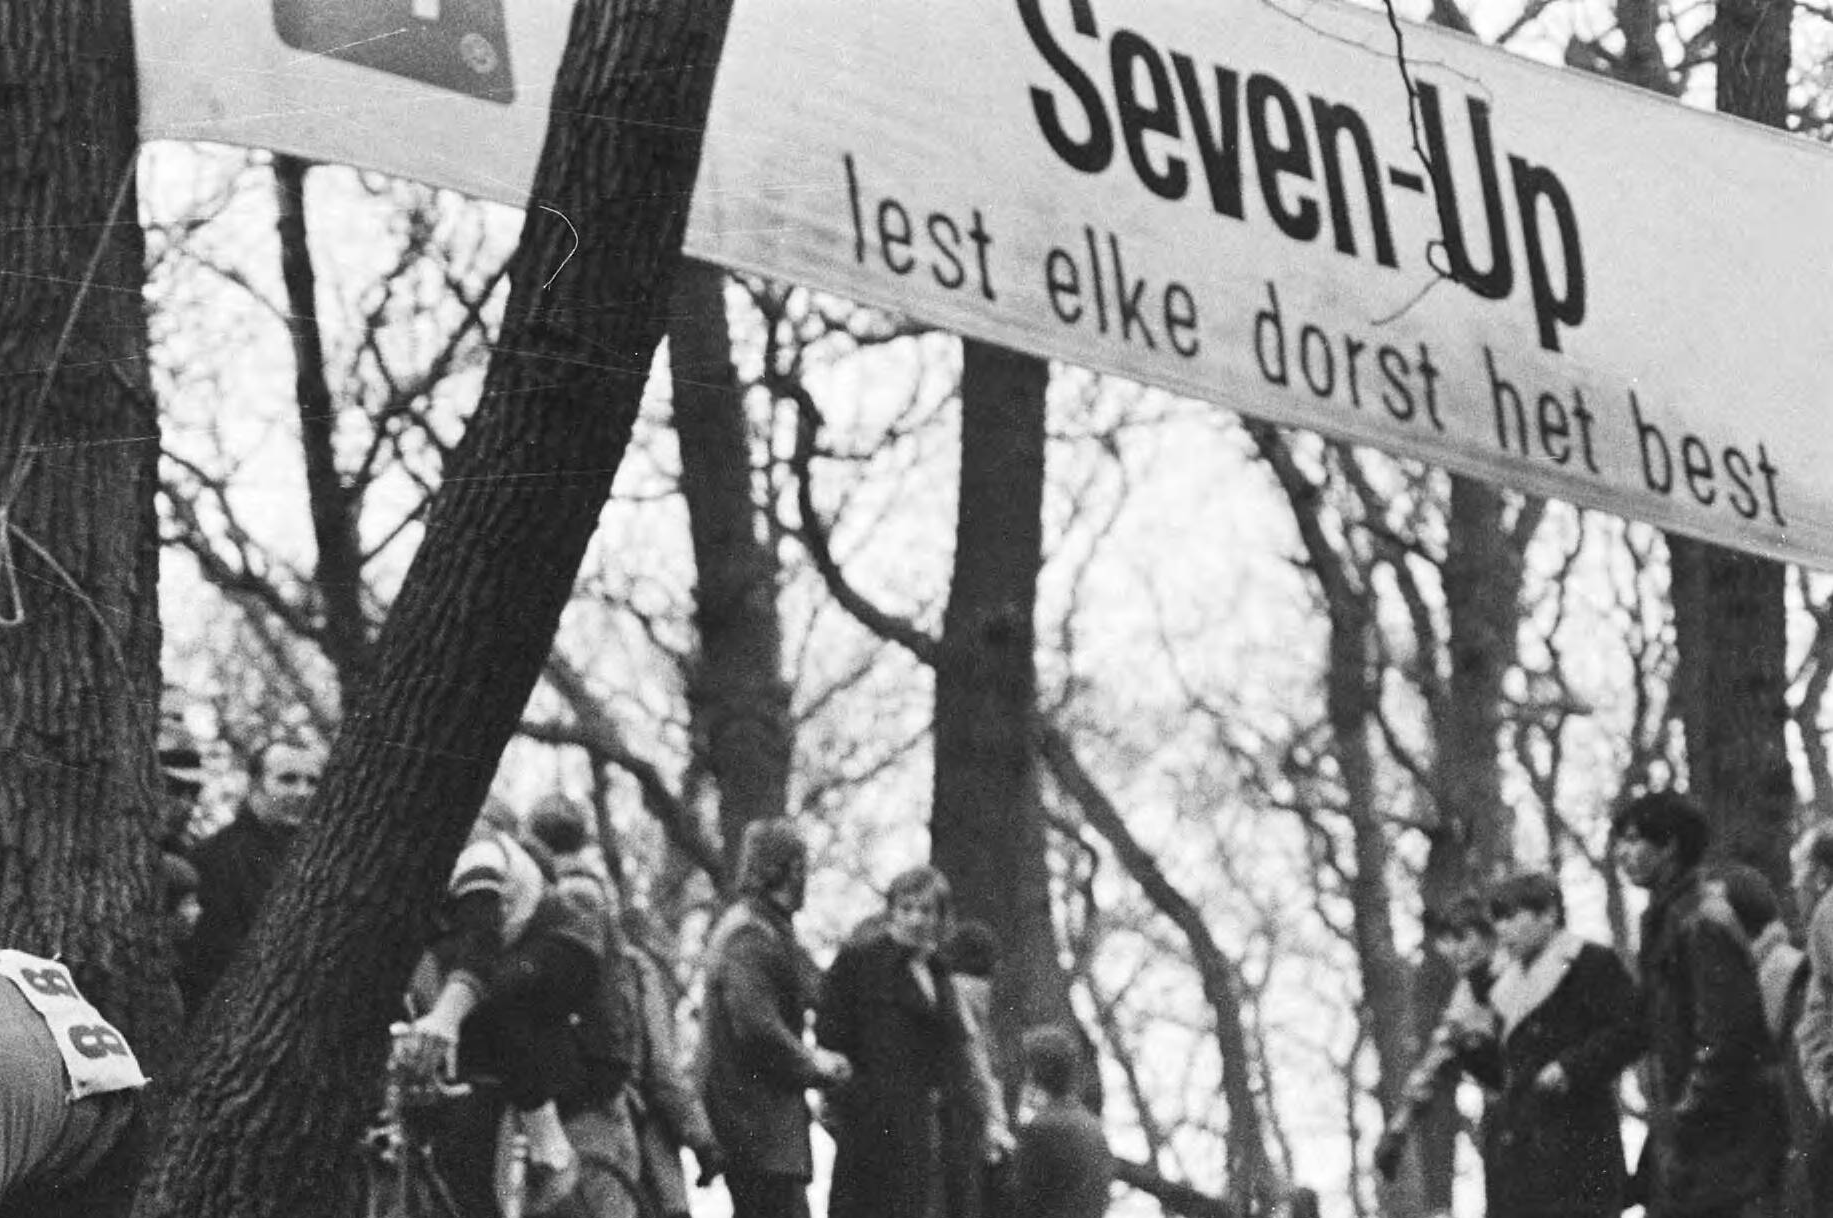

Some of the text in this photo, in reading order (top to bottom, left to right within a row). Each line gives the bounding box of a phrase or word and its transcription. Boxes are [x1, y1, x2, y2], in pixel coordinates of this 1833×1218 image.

[844, 152, 1788, 527] lest elke dorst het best
[1015, 0, 1587, 352] Seven-Up
